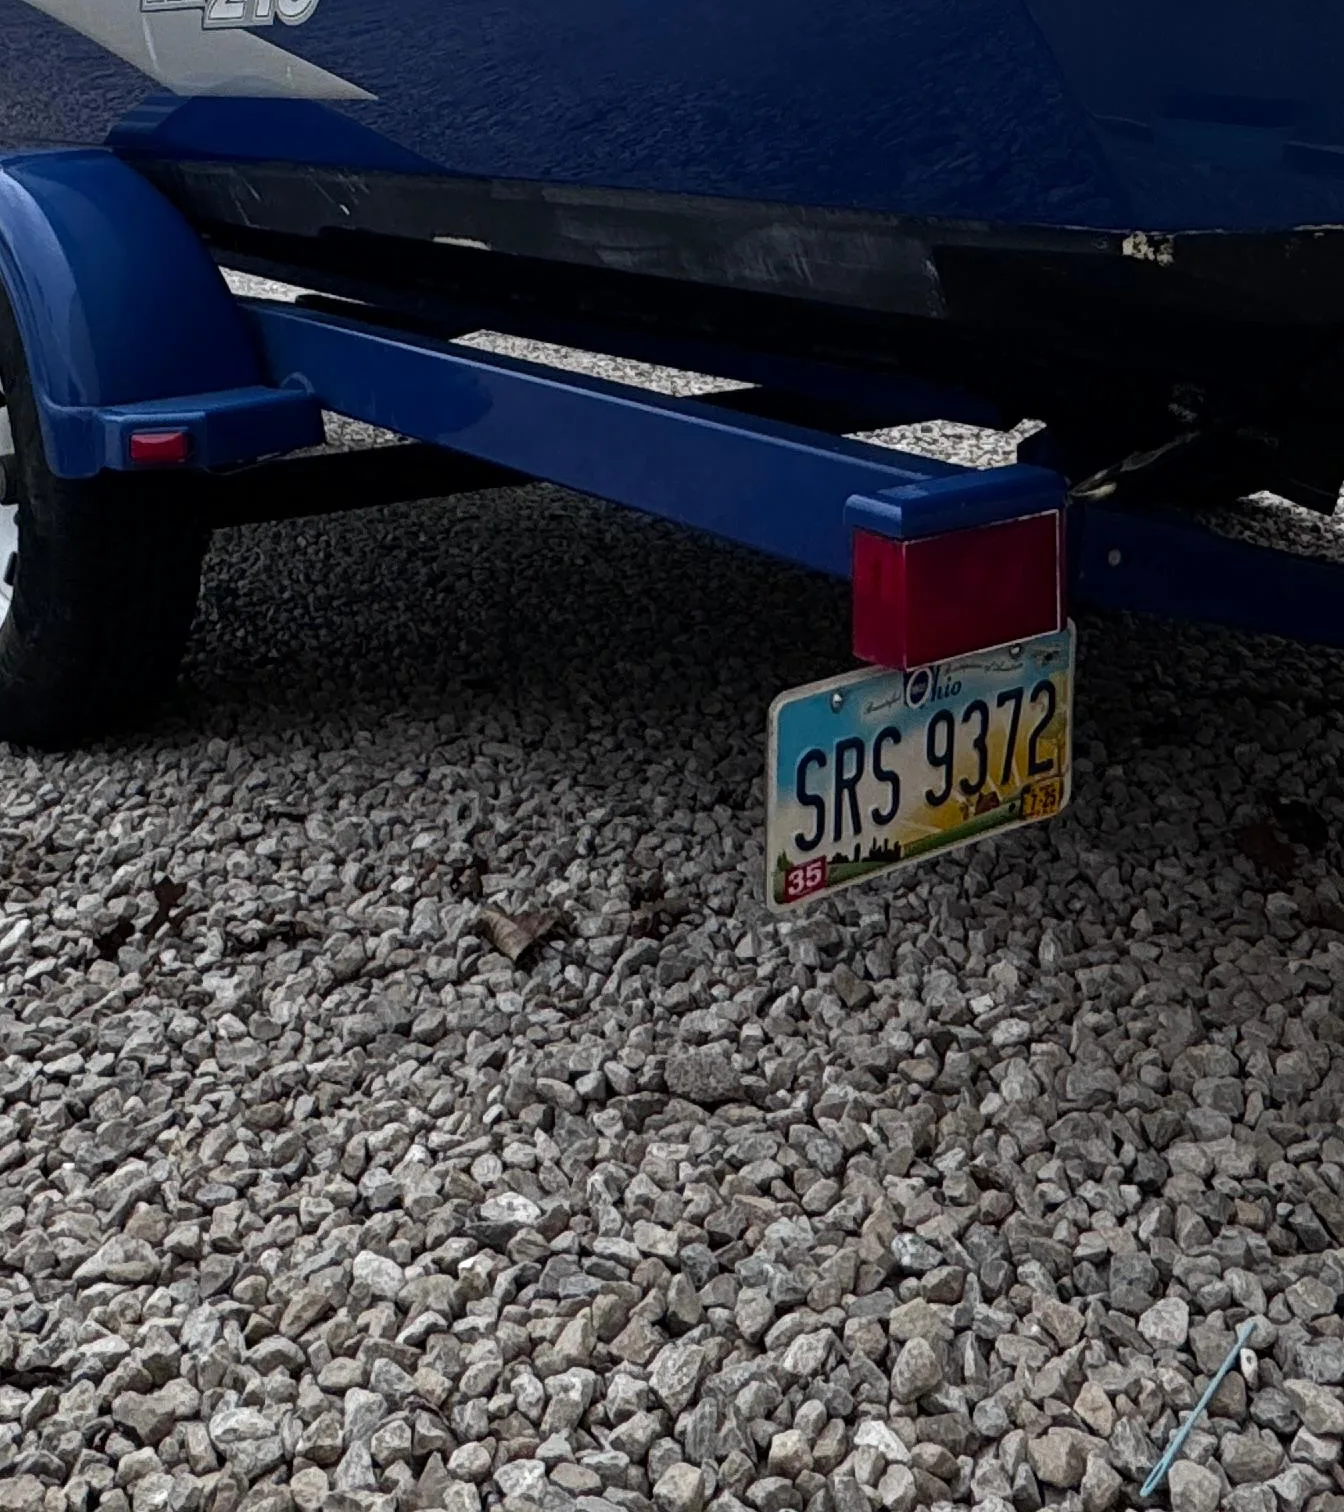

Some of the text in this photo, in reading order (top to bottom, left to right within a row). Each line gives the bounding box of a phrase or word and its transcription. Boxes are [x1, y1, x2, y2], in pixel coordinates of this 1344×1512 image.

[905, 659, 962, 710] Ohio
[794, 679, 1056, 852] SRS 9372
[788, 861, 822, 896] 35
